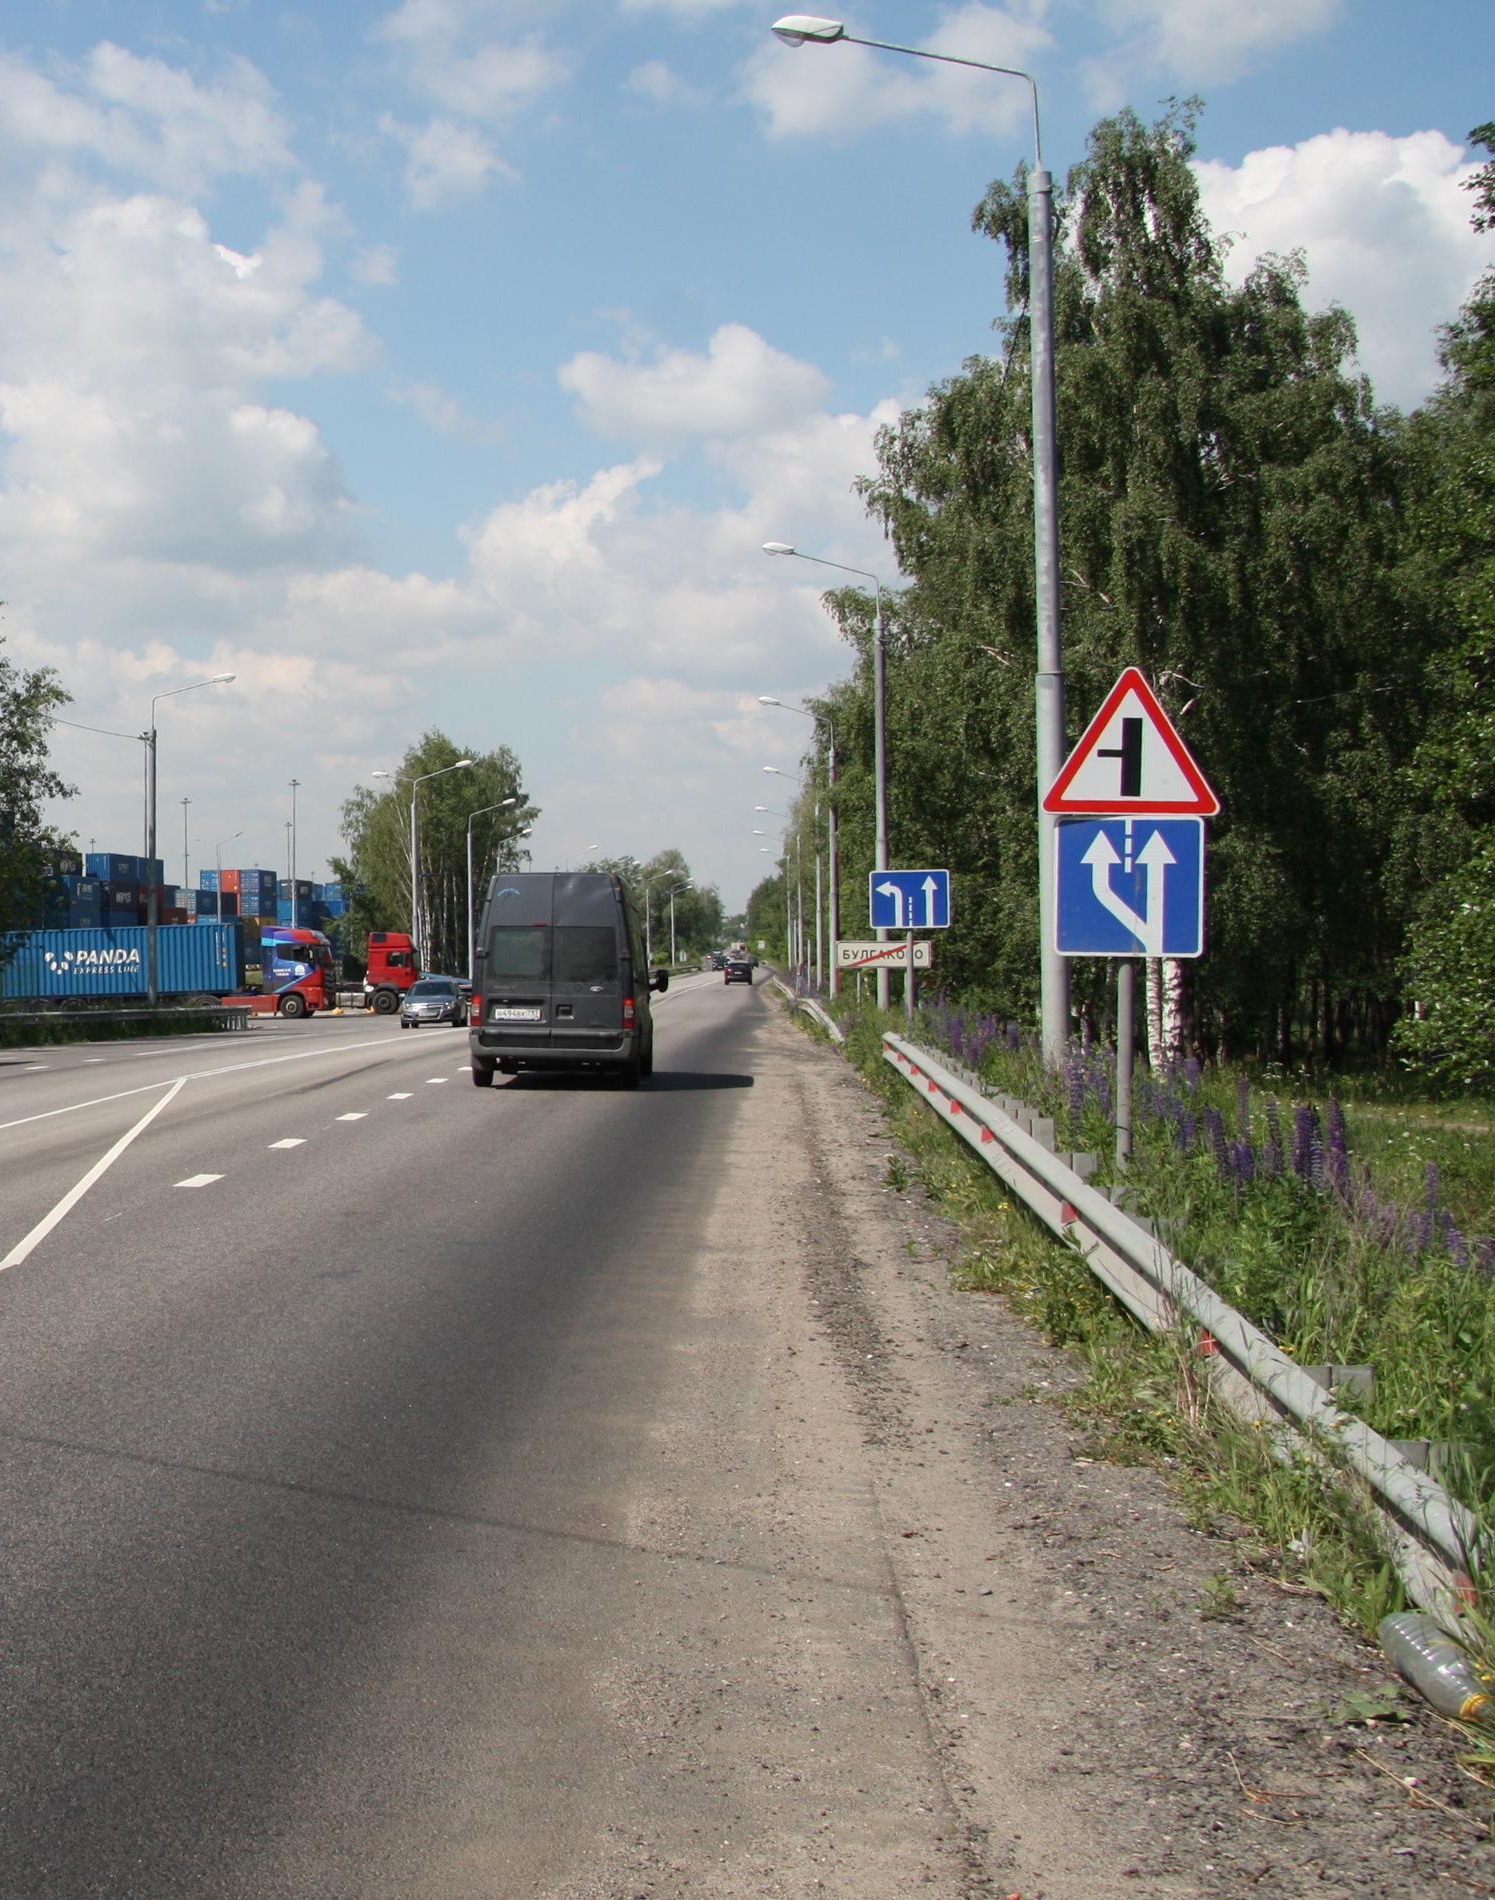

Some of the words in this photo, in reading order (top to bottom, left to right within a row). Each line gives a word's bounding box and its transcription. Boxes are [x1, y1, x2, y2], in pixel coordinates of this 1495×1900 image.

[76, 948, 140, 965] PANDA
[842, 949, 923, 960] БУЛГАКОО
[73, 965, 114, 975] EXPRESS
[117, 964, 140, 974] LINE
